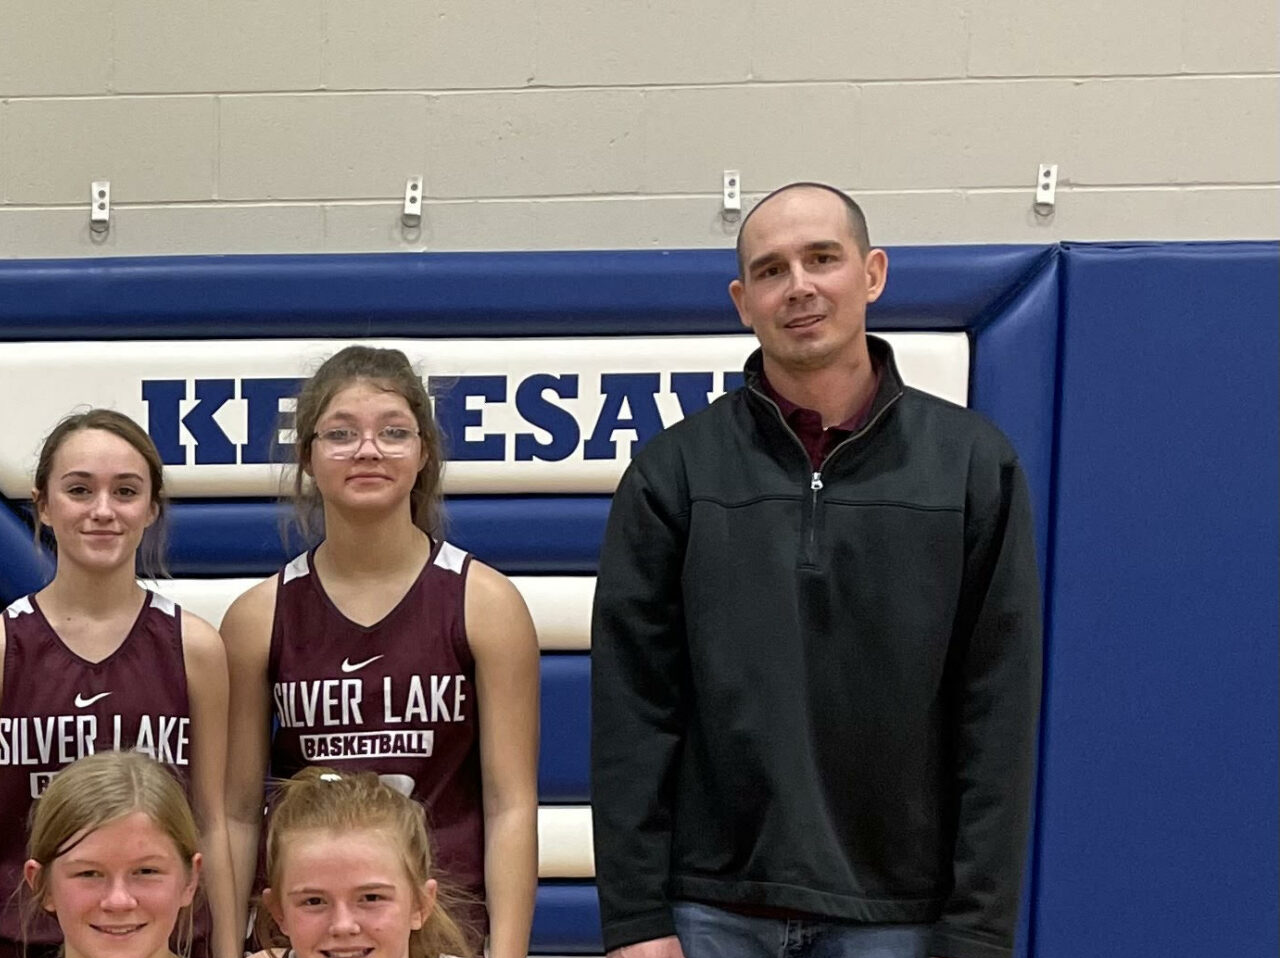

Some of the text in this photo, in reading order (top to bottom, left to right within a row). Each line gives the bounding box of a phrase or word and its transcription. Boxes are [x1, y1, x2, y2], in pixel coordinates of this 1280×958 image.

[141, 372, 748, 466] KEESA
[274, 674, 466, 728] SILVER LAKE
[113, 714, 191, 765] LAKE
[304, 732, 427, 758] BASKETBALL
